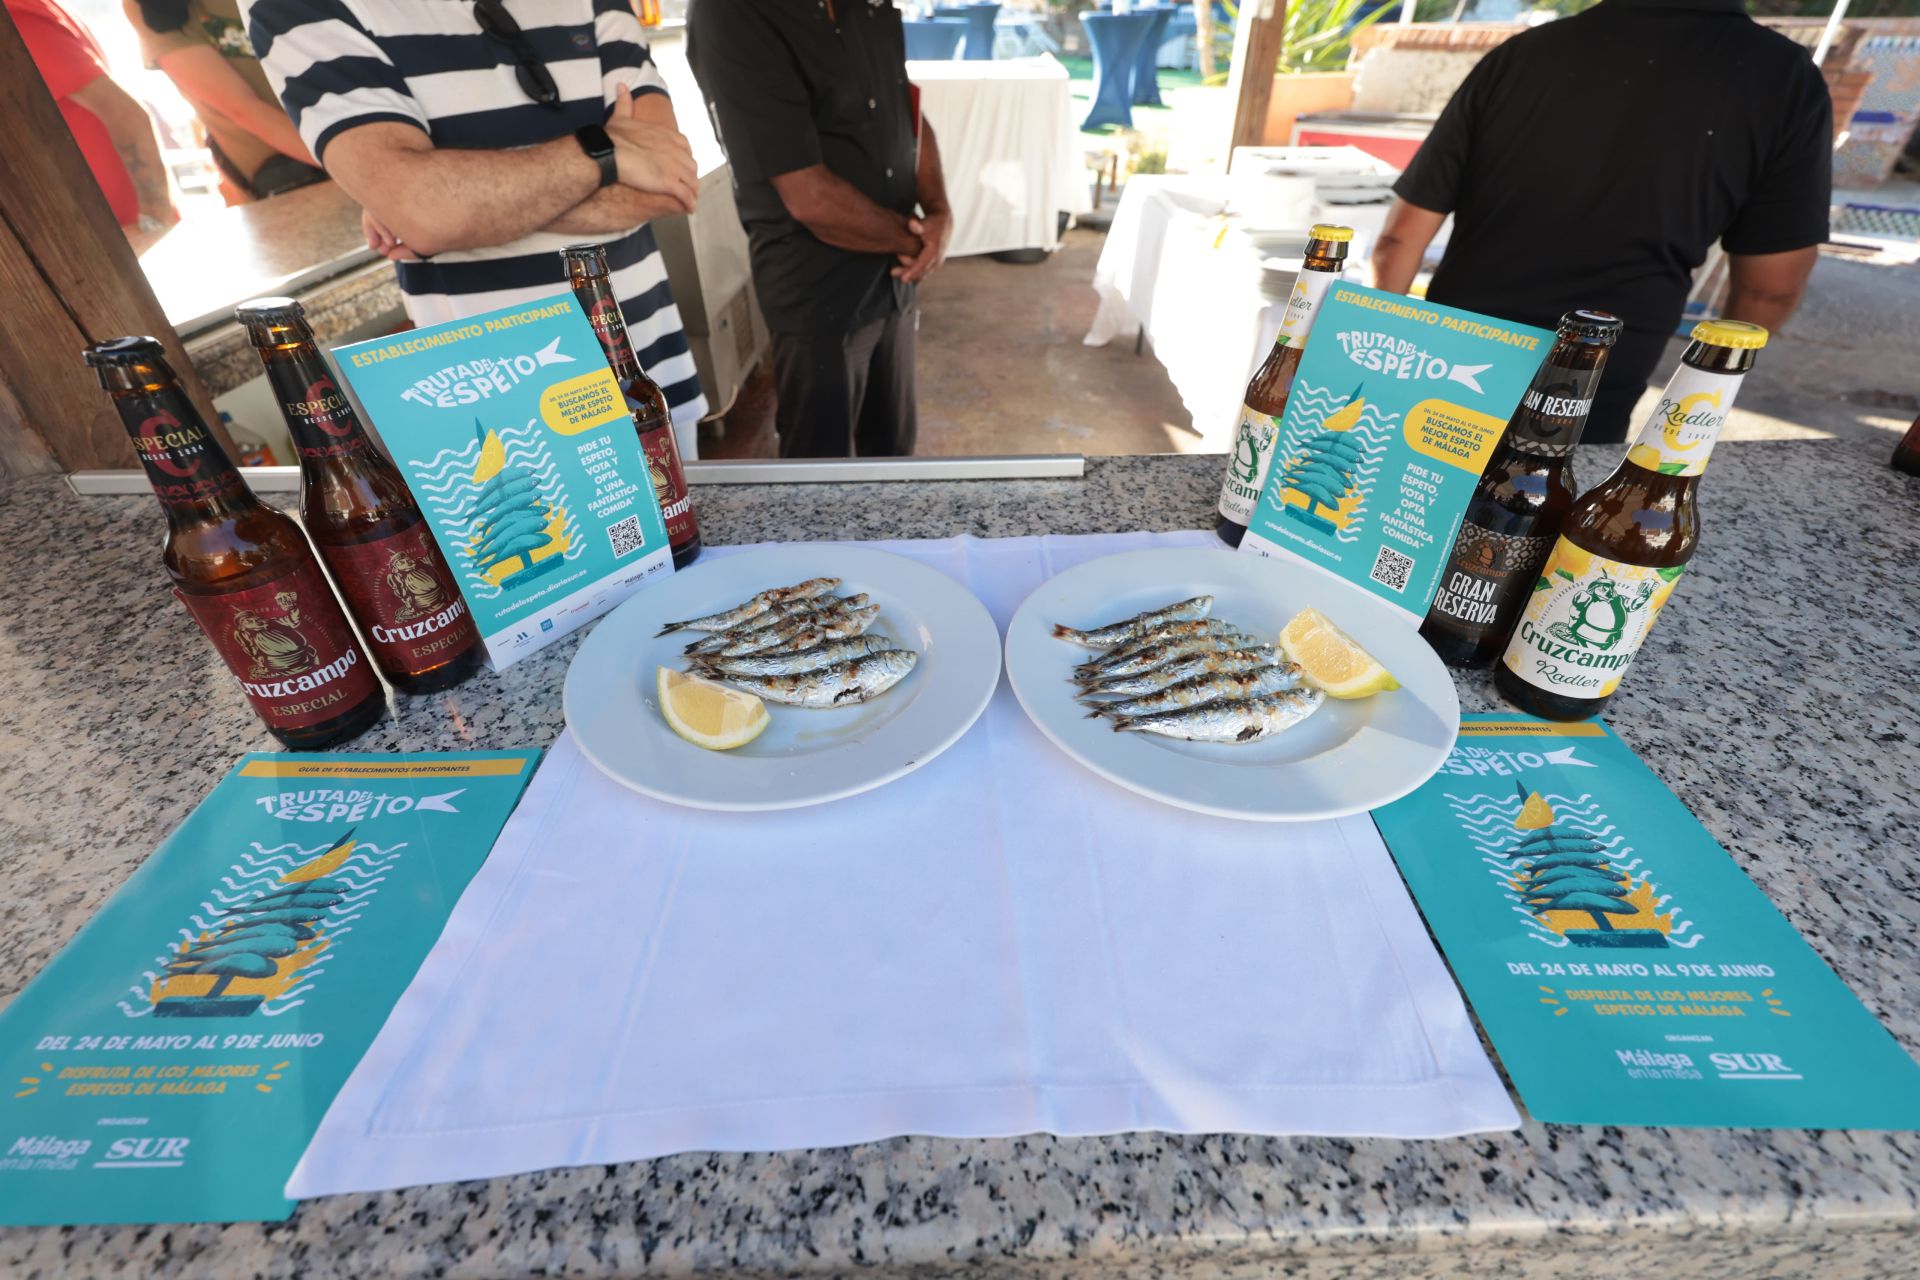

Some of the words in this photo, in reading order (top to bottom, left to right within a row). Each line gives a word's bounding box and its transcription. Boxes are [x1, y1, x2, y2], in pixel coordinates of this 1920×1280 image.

[1290, 296, 1313, 311] dler
[1334, 289, 1440, 325] ESTABLECIMIENTO
[1439, 315, 1541, 351] PARTICIPANTE
[351, 324, 484, 368] ESTABLECIMIENTO
[484, 301, 572, 334] PARTICIPANTE
[1350, 330, 1396, 353] RUTA
[1396, 338, 1417, 356] DEL
[1349, 348, 1448, 380] ESPETO
[413, 364, 476, 398] RUTA
[469, 358, 495, 376] DEL
[436, 355, 537, 408] ESPETO
[558, 389, 600, 409] BUSCAMOS
[600, 386, 609, 394] EL
[561, 404, 586, 418] MEJOR
[587, 394, 613, 408] ESPETO
[569, 415, 580, 424] DE
[1659, 398, 1724, 428] Radler
[132, 425, 208, 452] SPECIAL
[1420, 425, 1449, 441] MEJOR
[1449, 435, 1481, 452] ESPETO
[1422, 435, 1433, 445] DE
[1426, 416, 1474, 438] BUSCAMOS
[1474, 433, 1484, 443] EL
[577, 440, 599, 455] PIDE
[598, 435, 612, 448] TU
[580, 446, 616, 467] ESPETO,
[585, 461, 611, 476] VOTA
[612, 456, 620, 466] Y
[594, 469, 619, 485] OPTA
[1406, 463, 1429, 478] PIDE
[1429, 471, 1444, 485] TU
[595, 487, 604, 497] A
[603, 478, 625, 492] UNA
[1400, 485, 1425, 503] VOTA
[1428, 497, 1437, 507] Y
[1401, 473, 1439, 497] ESPETO,
[587, 483, 639, 512] FANTÁSTICA
[1400, 498, 1425, 516] OPTA
[1379, 512, 1434, 544] FANTÁSTICA
[1393, 507, 1401, 517] A
[1403, 511, 1425, 528] UNA
[1449, 571, 1497, 603] GRAN
[1433, 586, 1499, 624] RESERVA
[1521, 621, 1638, 671] Cruzcampo
[1536, 659, 1600, 689] Radler
[271, 689, 348, 717] ESPECIAL
[1493, 725, 1553, 733] PARTICIPANTES
[1437, 748, 1545, 777] SPETO
[1469, 746, 1495, 760] DEL
[333, 765, 410, 774] ESTABLECIMIENTOS
[411, 765, 471, 773] PARTICIPANTES
[274, 791, 414, 823] ESPETO
[279, 789, 344, 808] RUTA
[347, 789, 375, 803] DEL
[1506, 962, 1541, 976] DEL
[1541, 962, 1567, 976] 24
[1567, 963, 1592, 976] DE
[1593, 963, 1650, 977] MAYO
[1653, 963, 1678, 977] AL
[1676, 964, 1691, 977] 9
[1691, 964, 1718, 977] DE
[1717, 964, 1776, 978] JUNIO
[1564, 989, 1634, 1001] DISFRUTA
[1634, 989, 1656, 1001] DE
[1655, 989, 1685, 1002] LOS
[1685, 990, 1755, 1002] MEJORES
[1593, 1004, 1657, 1016] ESPETOS
[1658, 1004, 1679, 1016] DE
[1679, 1002, 1747, 1017] MÁLAGA
[35, 1035, 70, 1051] DEL
[72, 1035, 102, 1050] 24
[102, 1035, 132, 1050] DE
[131, 1034, 193, 1050] MAYO
[192, 1034, 219, 1050] AL
[222, 1034, 237, 1049] 9
[236, 1034, 260, 1049] DE
[262, 1032, 325, 1049] JUNIO
[57, 1066, 130, 1080] DISFRUTA
[132, 1066, 154, 1079] DE
[156, 1065, 189, 1079] LOS
[189, 1064, 260, 1078] MEJORES
[1615, 1049, 1694, 1070] Málaga
[1709, 1052, 1793, 1072] SUR
[64, 1082, 133, 1097] ESPETOS
[133, 1082, 155, 1096] DE
[155, 1079, 227, 1096] MÁLAGA
[8, 1135, 92, 1160] Málaga
[104, 1137, 191, 1160] SUR
